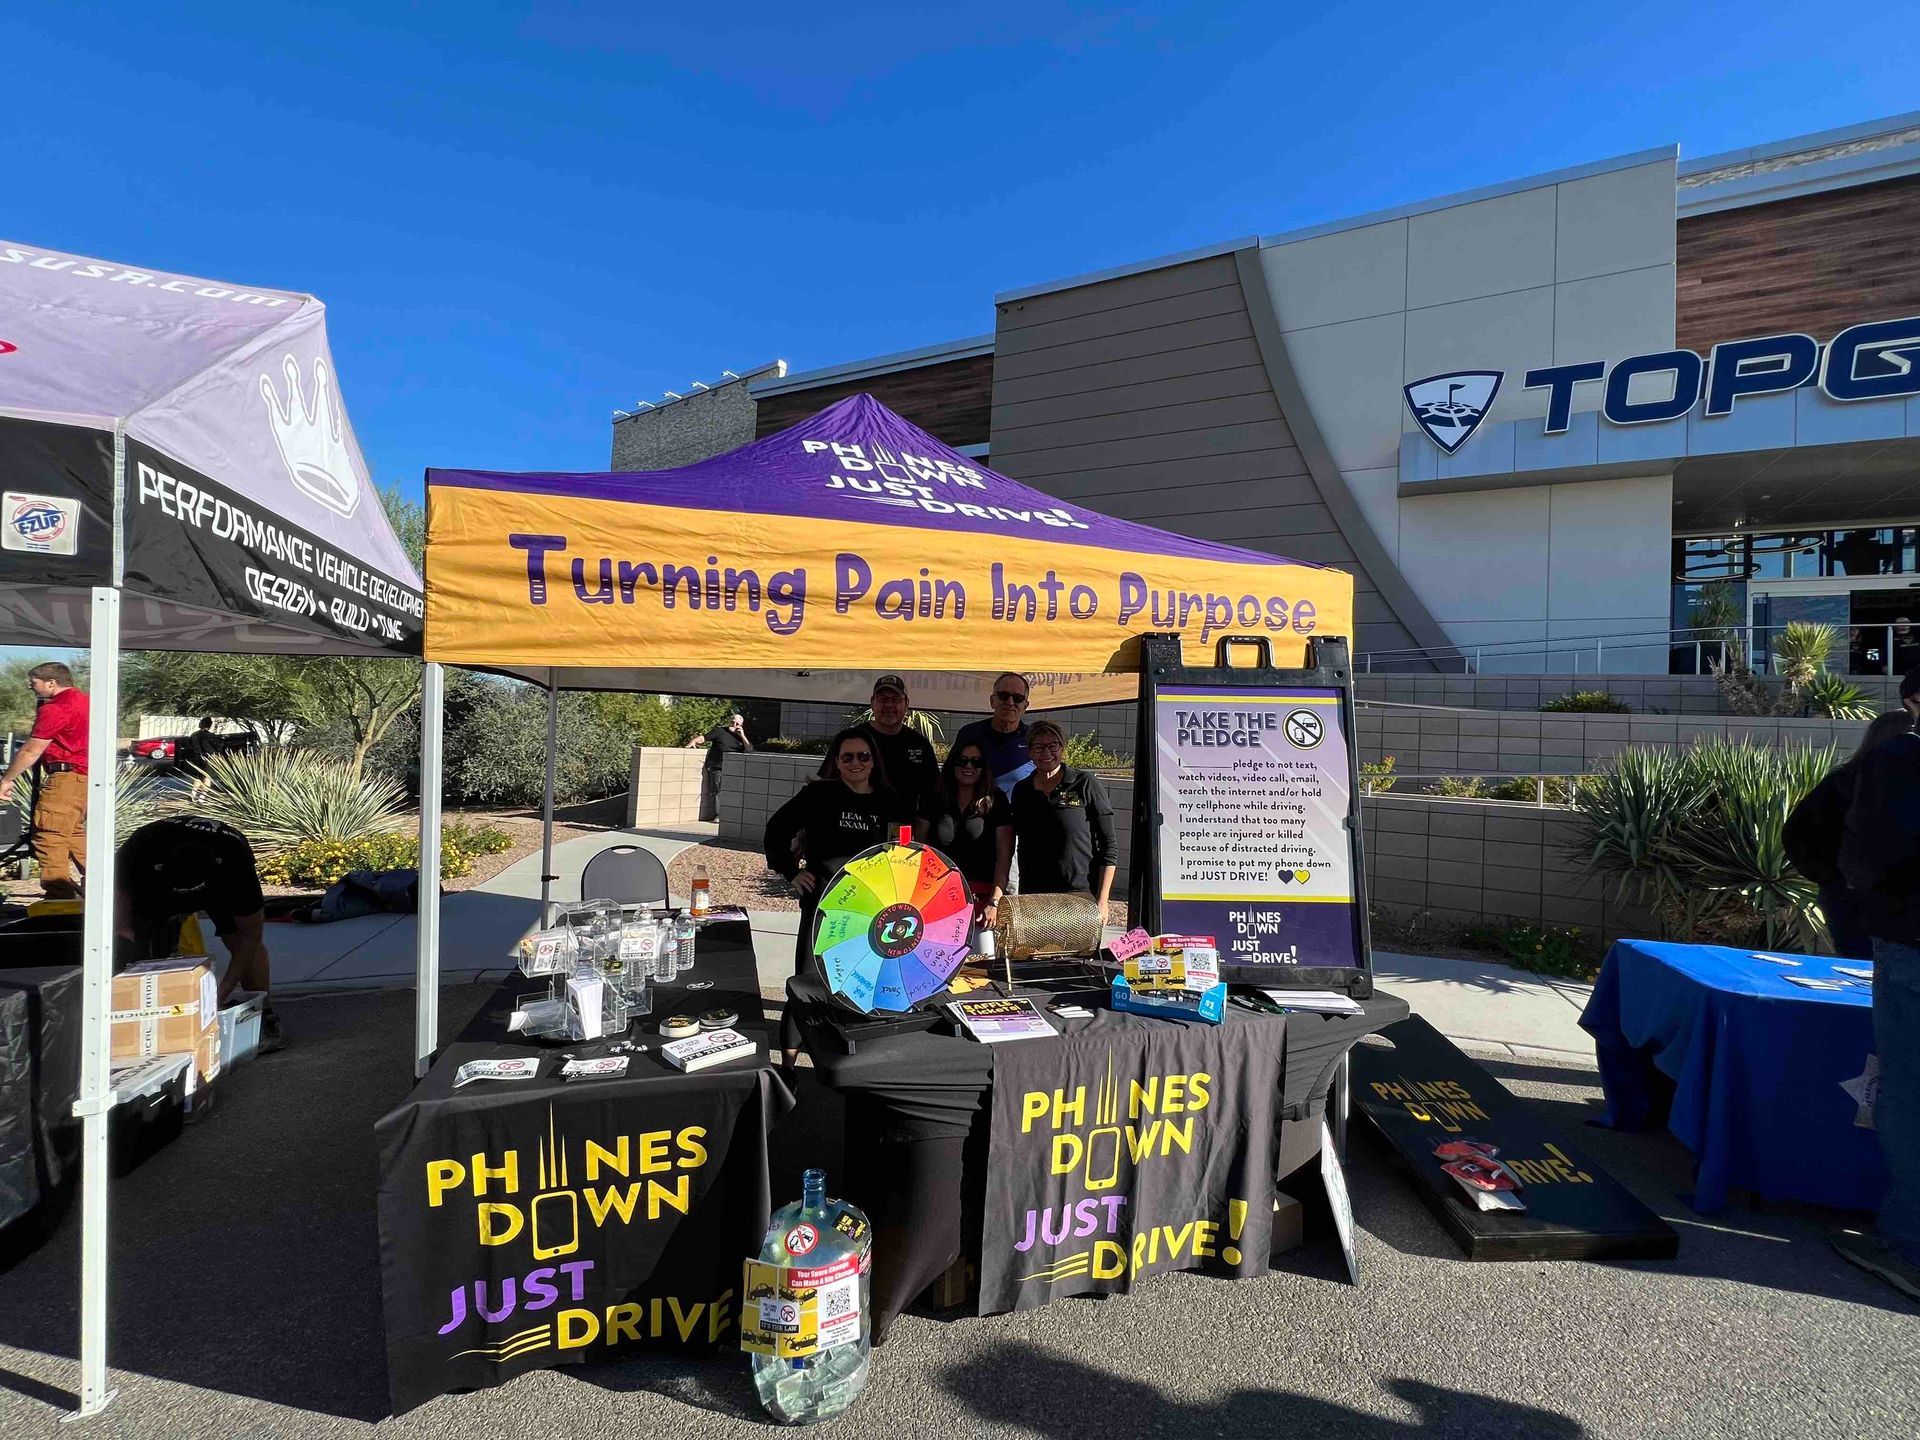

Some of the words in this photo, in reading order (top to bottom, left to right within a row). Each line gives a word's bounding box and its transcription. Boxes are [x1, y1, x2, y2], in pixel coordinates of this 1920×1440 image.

[825, 475, 936, 499] JUST
[916, 499, 1090, 530] DRIVE!
[138, 461, 314, 574] PERFORMANCE
[315, 548, 368, 596] VEHICLE
[508, 532, 807, 636] Turning
[835, 552, 966, 621] Pain
[990, 562, 1099, 623] Into
[1117, 571, 1317, 645] Purpose
[244, 566, 316, 617] DESIGN
[330, 597, 369, 632] BUILD
[377, 614, 404, 641] TUNE
[1175, 710, 1230, 730] TAKE
[1233, 712, 1277, 730] THE
[1177, 729, 1262, 748] PLEDGE
[1178, 759, 1181, 767] I
[1233, 759, 1263, 772] pledge
[1266, 761, 1275, 769] to
[1278, 761, 1293, 769] not
[1295, 761, 1318, 771] text,
[1178, 772, 1205, 781] watch
[1208, 772, 1240, 783] videos,
[1243, 773, 1267, 782] video
[1269, 773, 1289, 784] call,
[1291, 774, 1319, 785] email,
[1178, 787, 1208, 796] search
[1211, 787, 1226, 796] the
[1228, 787, 1266, 796] internet
[1268, 787, 1299, 797] and/or
[1301, 788, 1321, 797] hold
[1179, 802, 1193, 811] my
[1196, 801, 1241, 812] cellphone
[1243, 801, 1268, 810] while
[1271, 802, 1306, 814] driving.
[1179, 815, 1183, 823] I
[1185, 815, 1239, 824] understand
[1241, 816, 1260, 825] that
[1262, 816, 1278, 825] too
[1280, 818, 1306, 828] many
[1179, 829, 1210, 841] people
[1213, 830, 1227, 838] are
[1229, 829, 1263, 841] injured
[1265, 831, 1275, 839] or
[1277, 829, 1303, 839] killed
[1180, 843, 1217, 852] because
[1219, 843, 1229, 852] of
[1232, 843, 1278, 853] distracted
[1281, 844, 1316, 856] driving.
[1180, 857, 1184, 866] I
[1186, 858, 1224, 870] promise
[1226, 859, 1236, 867] to
[1239, 859, 1255, 870] put
[1258, 860, 1272, 871] my
[1275, 859, 1304, 871] phone
[1306, 859, 1331, 868] down
[1180, 871, 1197, 880] and
[1200, 871, 1226, 881] JUST
[1229, 872, 1268, 881] DRIVE!
[877, 911, 889, 928] SPIN
[888, 905, 897, 913] TO
[898, 904, 913, 912] WIN
[1231, 940, 1261, 951] JUST
[1252, 946, 1298, 964] DRIVE!
[1115, 991, 1128, 1000] 60
[1050, 1117, 1194, 1191] DOWN
[1505, 1142, 1594, 1184] RIVE!
[477, 1175, 690, 1261] DOWN
[1013, 1195, 1127, 1253] JUST
[1092, 1198, 1248, 1281] DRIVE!
[791, 1279, 803, 1287] Can
[437, 1260, 595, 1336] JUST
